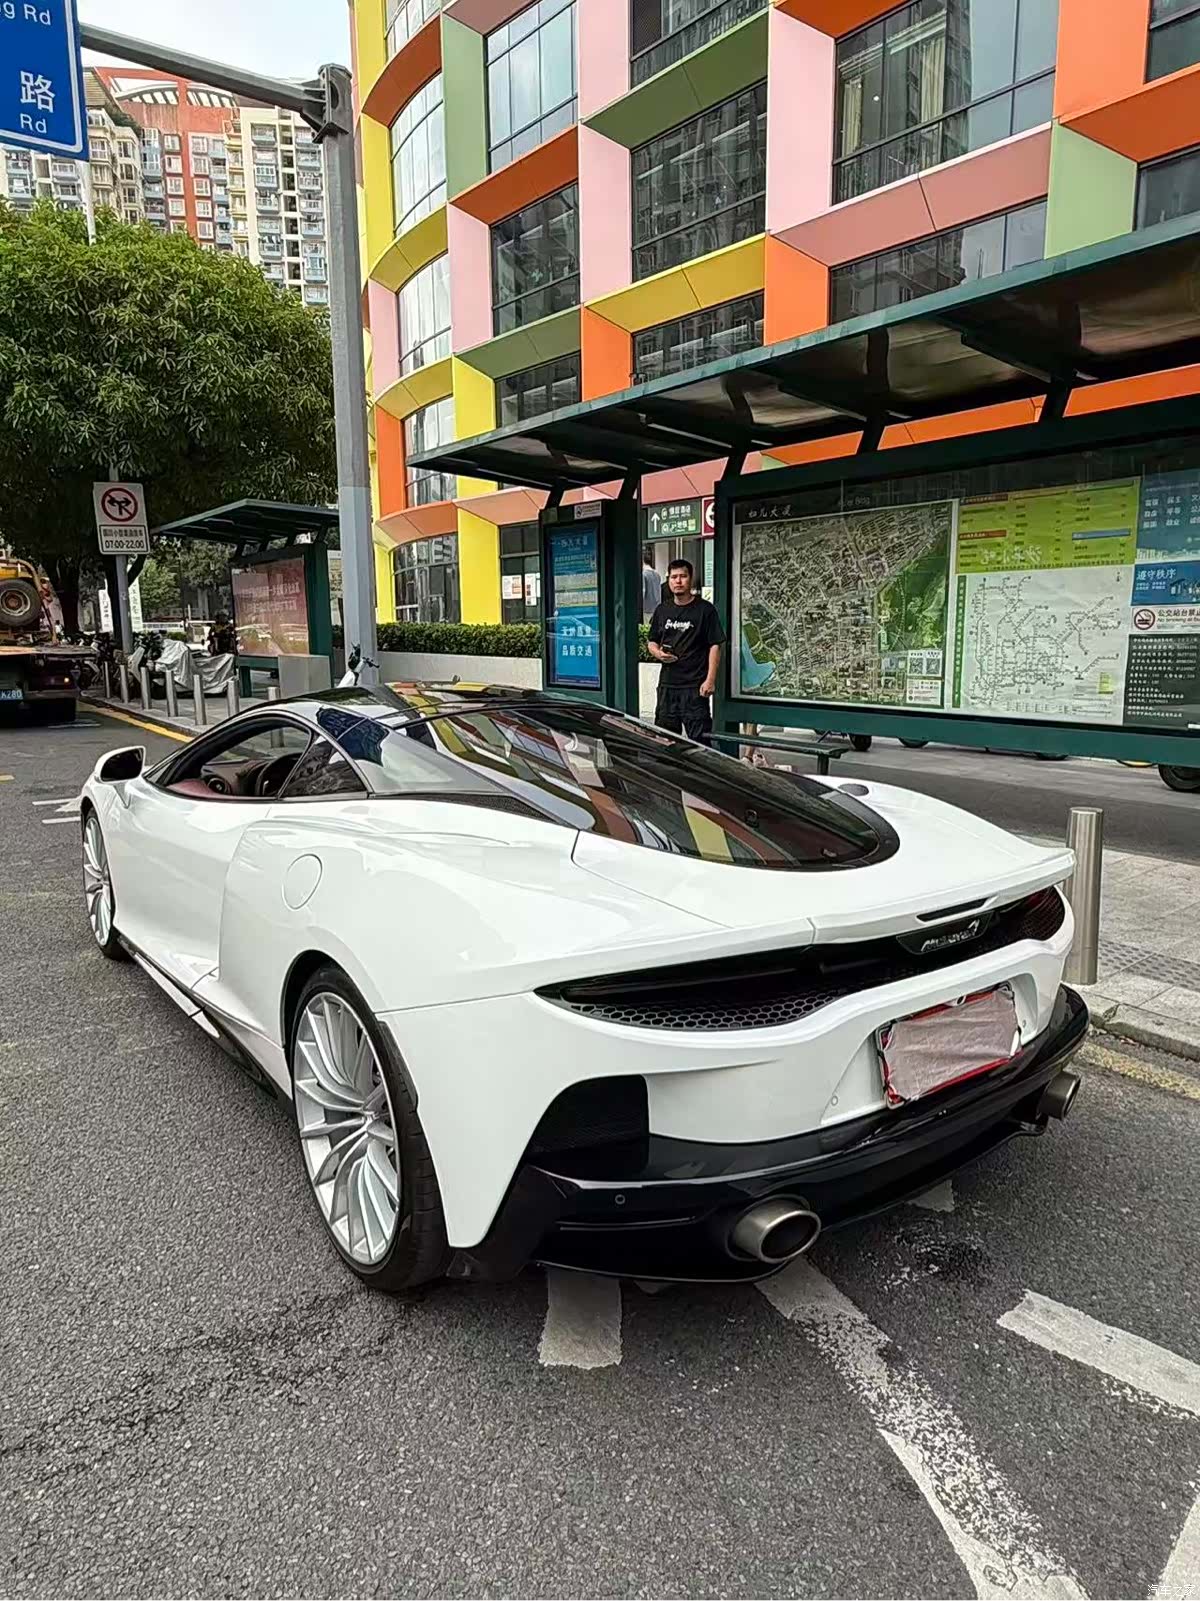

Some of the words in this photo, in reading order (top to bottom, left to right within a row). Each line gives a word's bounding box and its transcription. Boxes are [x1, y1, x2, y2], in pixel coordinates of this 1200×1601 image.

[0, 1, 16, 20] g
[24, 3, 52, 26] Rd
[20, 70, 57, 114] 路
[20, 114, 48, 135] Rd
[1136, 568, 1176, 580] 遵守秩序
[562, 645, 593, 657] 品质交通
